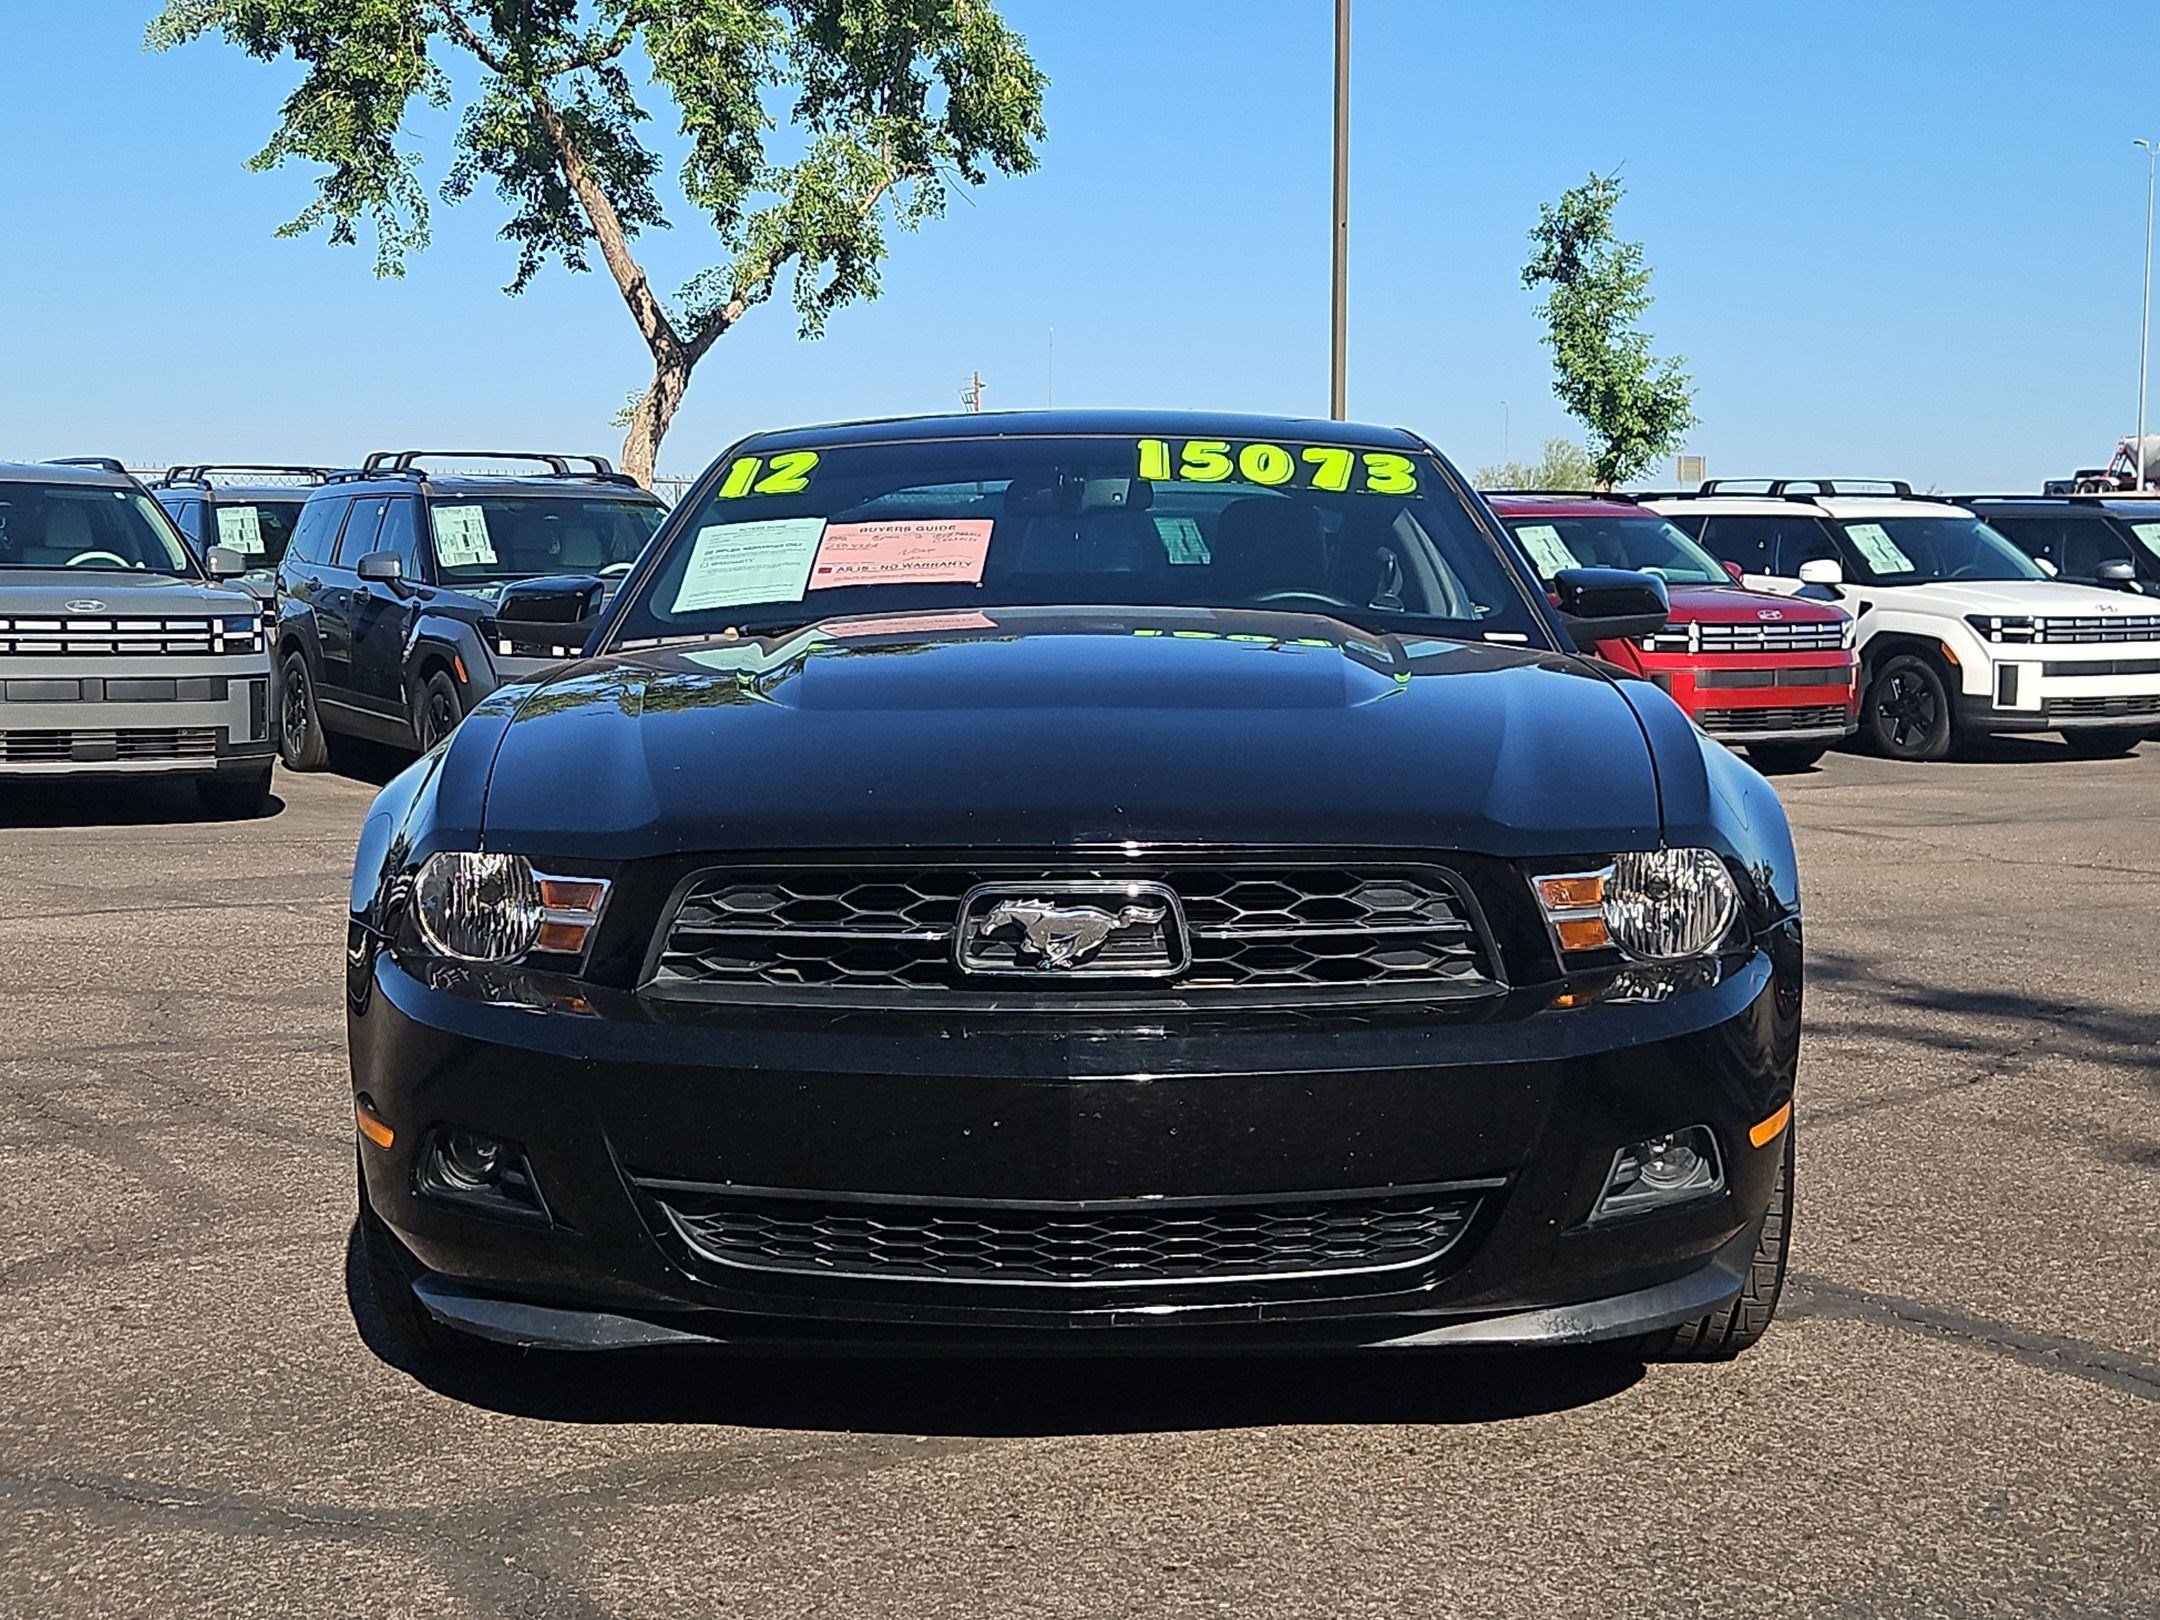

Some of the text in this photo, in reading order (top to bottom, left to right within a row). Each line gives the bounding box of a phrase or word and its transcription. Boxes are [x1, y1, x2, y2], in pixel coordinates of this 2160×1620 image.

[718, 451, 820, 498] 12
[1137, 439, 1418, 494] 15073
[859, 524, 957, 533] BUYERS GUIDE
[880, 563, 899, 572] NO
[902, 561, 972, 570] WARRANTY
